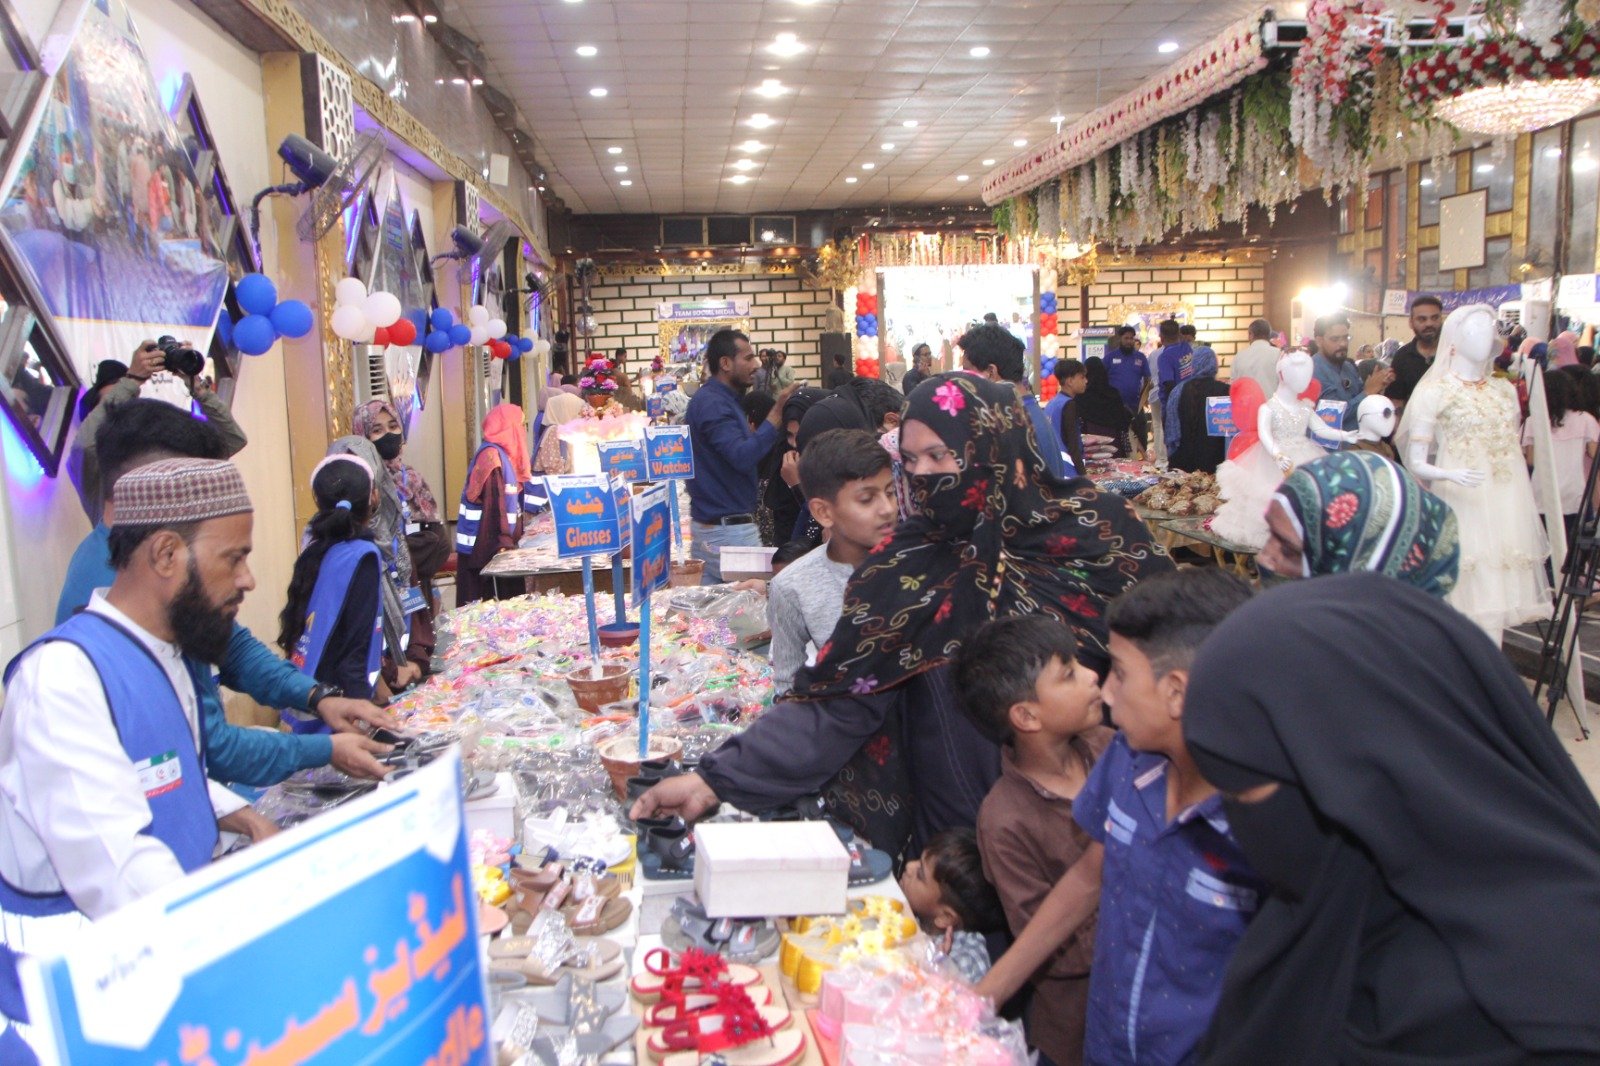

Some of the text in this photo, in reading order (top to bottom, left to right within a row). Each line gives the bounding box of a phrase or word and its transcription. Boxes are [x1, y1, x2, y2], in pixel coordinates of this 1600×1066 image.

[652, 460, 691, 476] Watches
[566, 490, 604, 519] چشمہ
[565, 528, 611, 548] Glasses
[153, 976, 361, 1066] سینڈ
